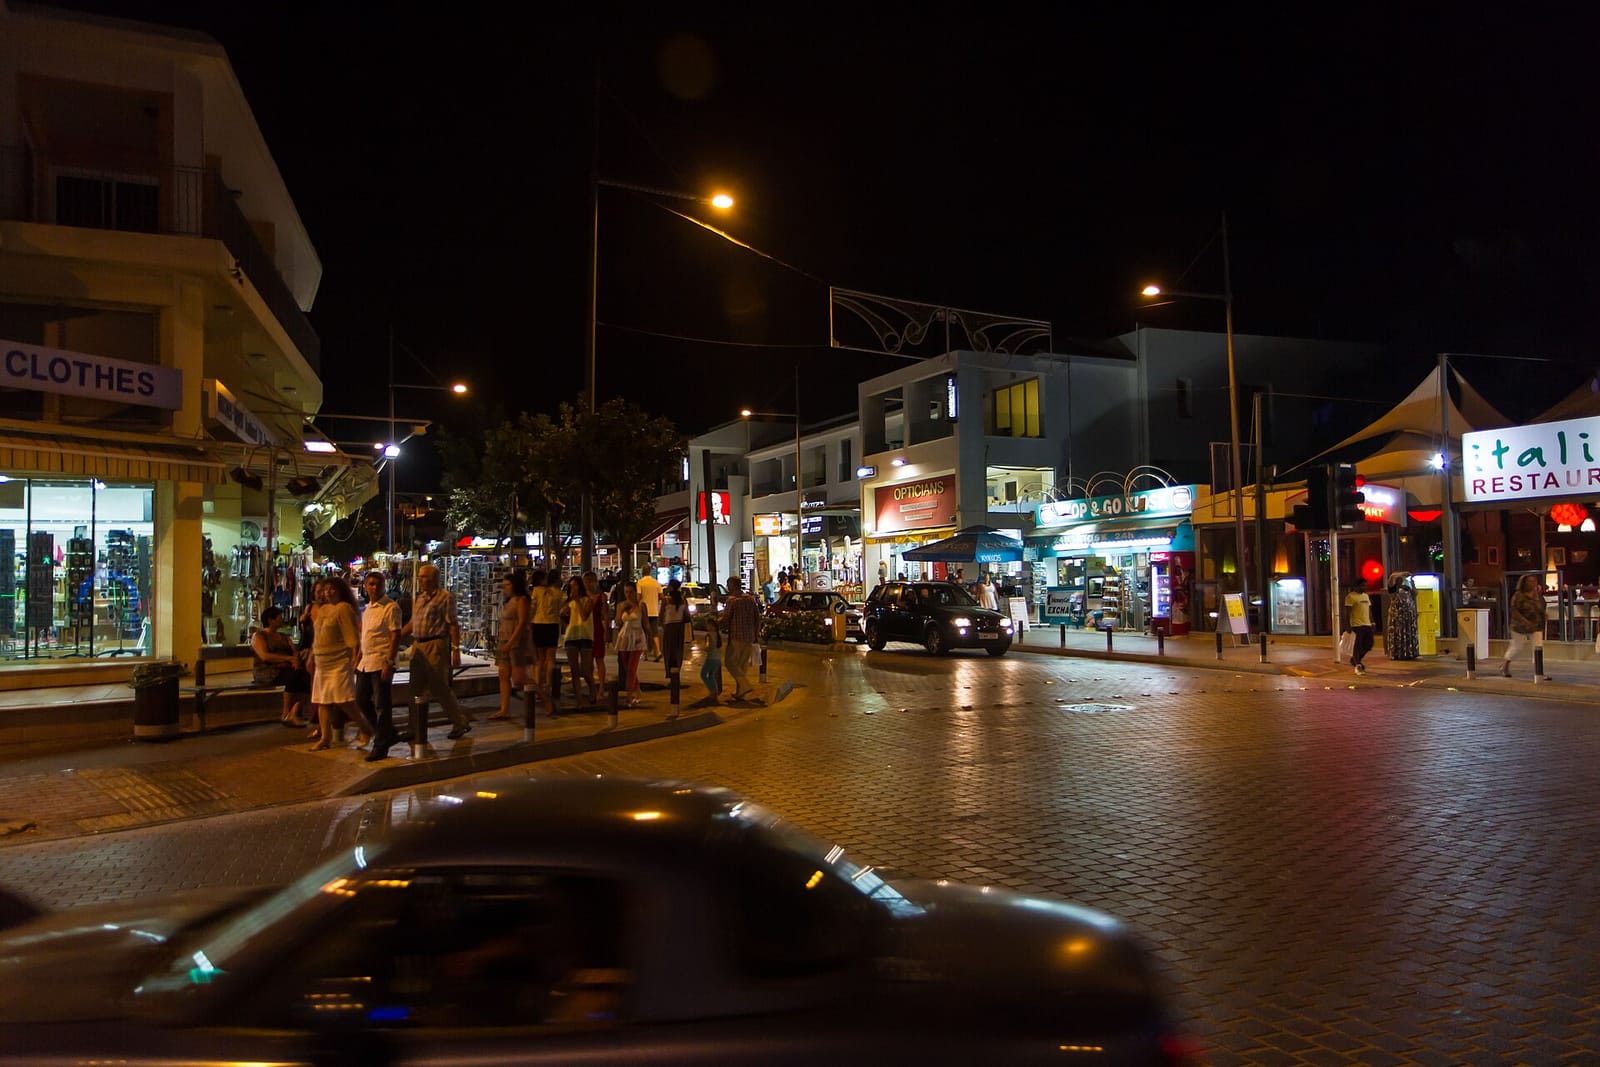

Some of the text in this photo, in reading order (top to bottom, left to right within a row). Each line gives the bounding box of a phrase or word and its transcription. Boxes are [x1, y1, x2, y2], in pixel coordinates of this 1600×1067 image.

[5, 350, 155, 396] CLOTHES
[893, 480, 944, 501] OPTICIANS
[1472, 468, 1600, 495] RESTAUR
[1091, 501, 1100, 516] &
[1103, 498, 1121, 514] GO
